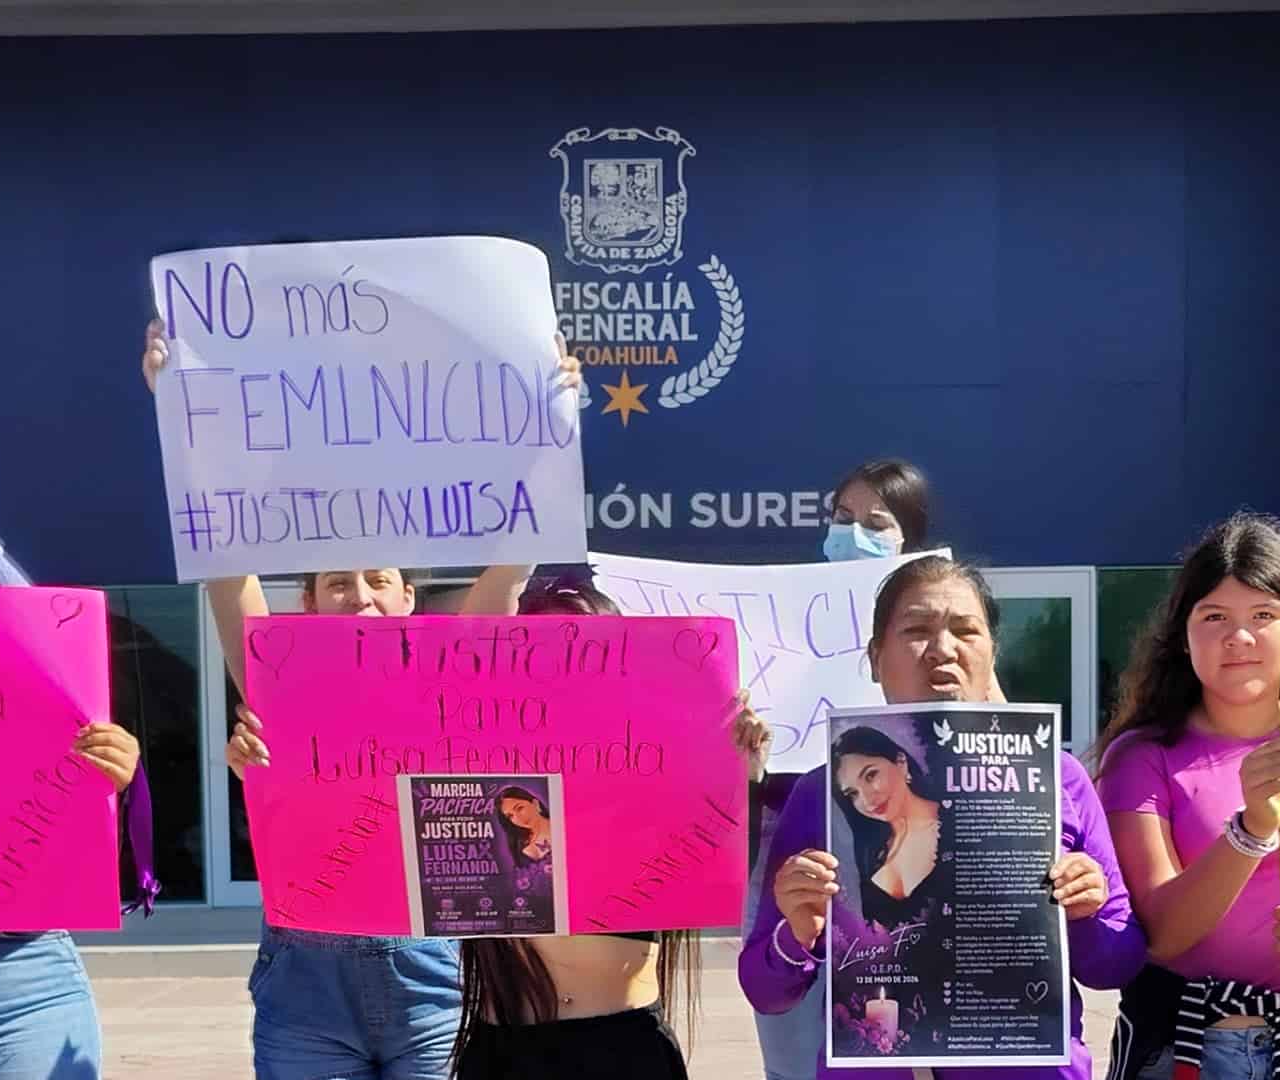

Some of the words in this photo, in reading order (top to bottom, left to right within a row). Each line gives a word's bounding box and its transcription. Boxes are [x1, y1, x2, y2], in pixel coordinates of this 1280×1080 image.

[609, 247, 631, 259] DE
[165, 261, 255, 340] NO
[283, 265, 389, 338] más
[555, 272, 695, 310] FISCALÍA
[558, 312, 698, 341] GENERAL
[952, 733, 1033, 756] JUSTICIA
[980, 756, 1010, 766] PARA
[430, 783, 484, 798] MARCHA
[946, 766, 1020, 793] LUISA
[1027, 767, 1046, 792] F.
[421, 821, 495, 839] JUSTICIA
[423, 860, 499, 875] FERNANDA
[837, 936, 889, 971] Luisa
